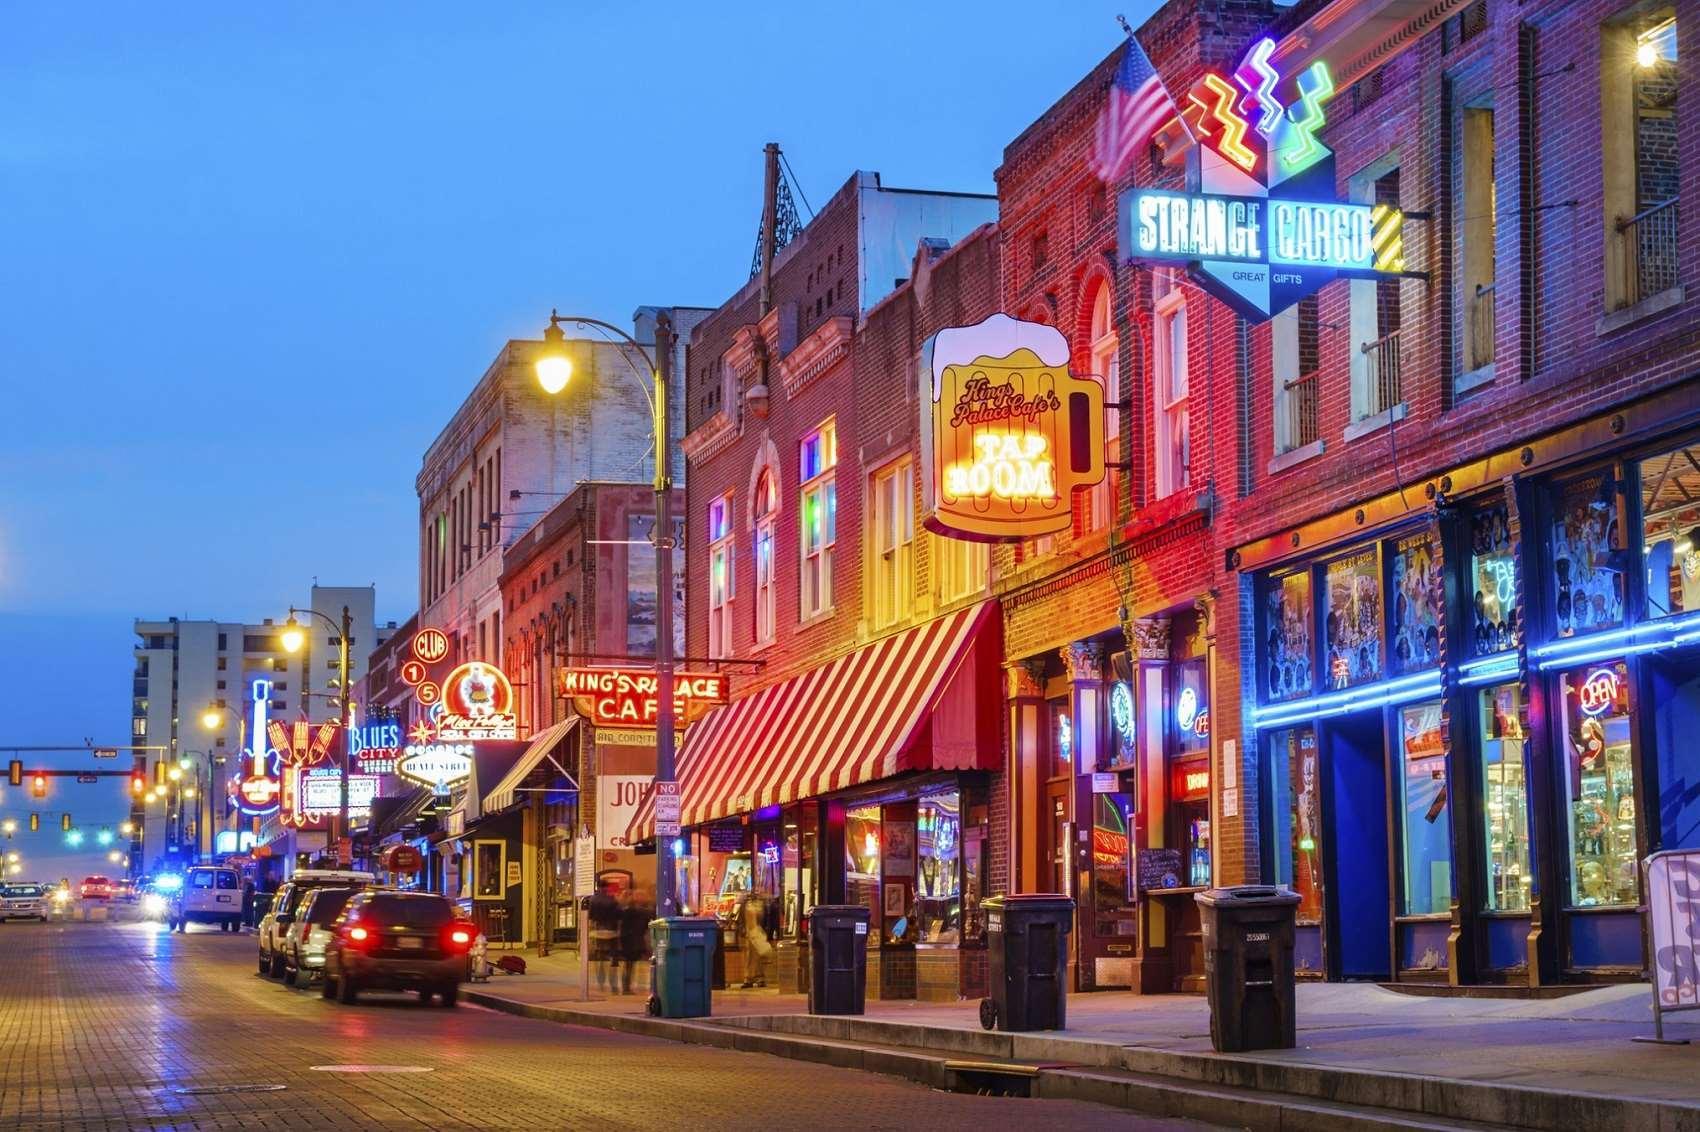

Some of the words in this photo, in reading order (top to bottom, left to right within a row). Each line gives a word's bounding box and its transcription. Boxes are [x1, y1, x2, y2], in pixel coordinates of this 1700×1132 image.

[1138, 195, 1262, 258] STRANGE
[1274, 203, 1370, 263] CARGO
[1232, 271, 1265, 283] GREAT
[1273, 273, 1303, 284] GIFTS
[960, 377, 1015, 408] Kings
[950, 401, 1010, 428] Palace
[976, 434, 1047, 461] TAP
[948, 461, 1056, 497] ROOM
[417, 632, 445, 659] CLUB
[408, 666, 417, 681] 1
[566, 671, 630, 692] KING'S
[423, 686, 434, 701] 5
[1580, 678, 1618, 707] OPEN
[351, 725, 399, 756] BLUES
[359, 748, 398, 759] CITY
[660, 785, 676, 794] NO
